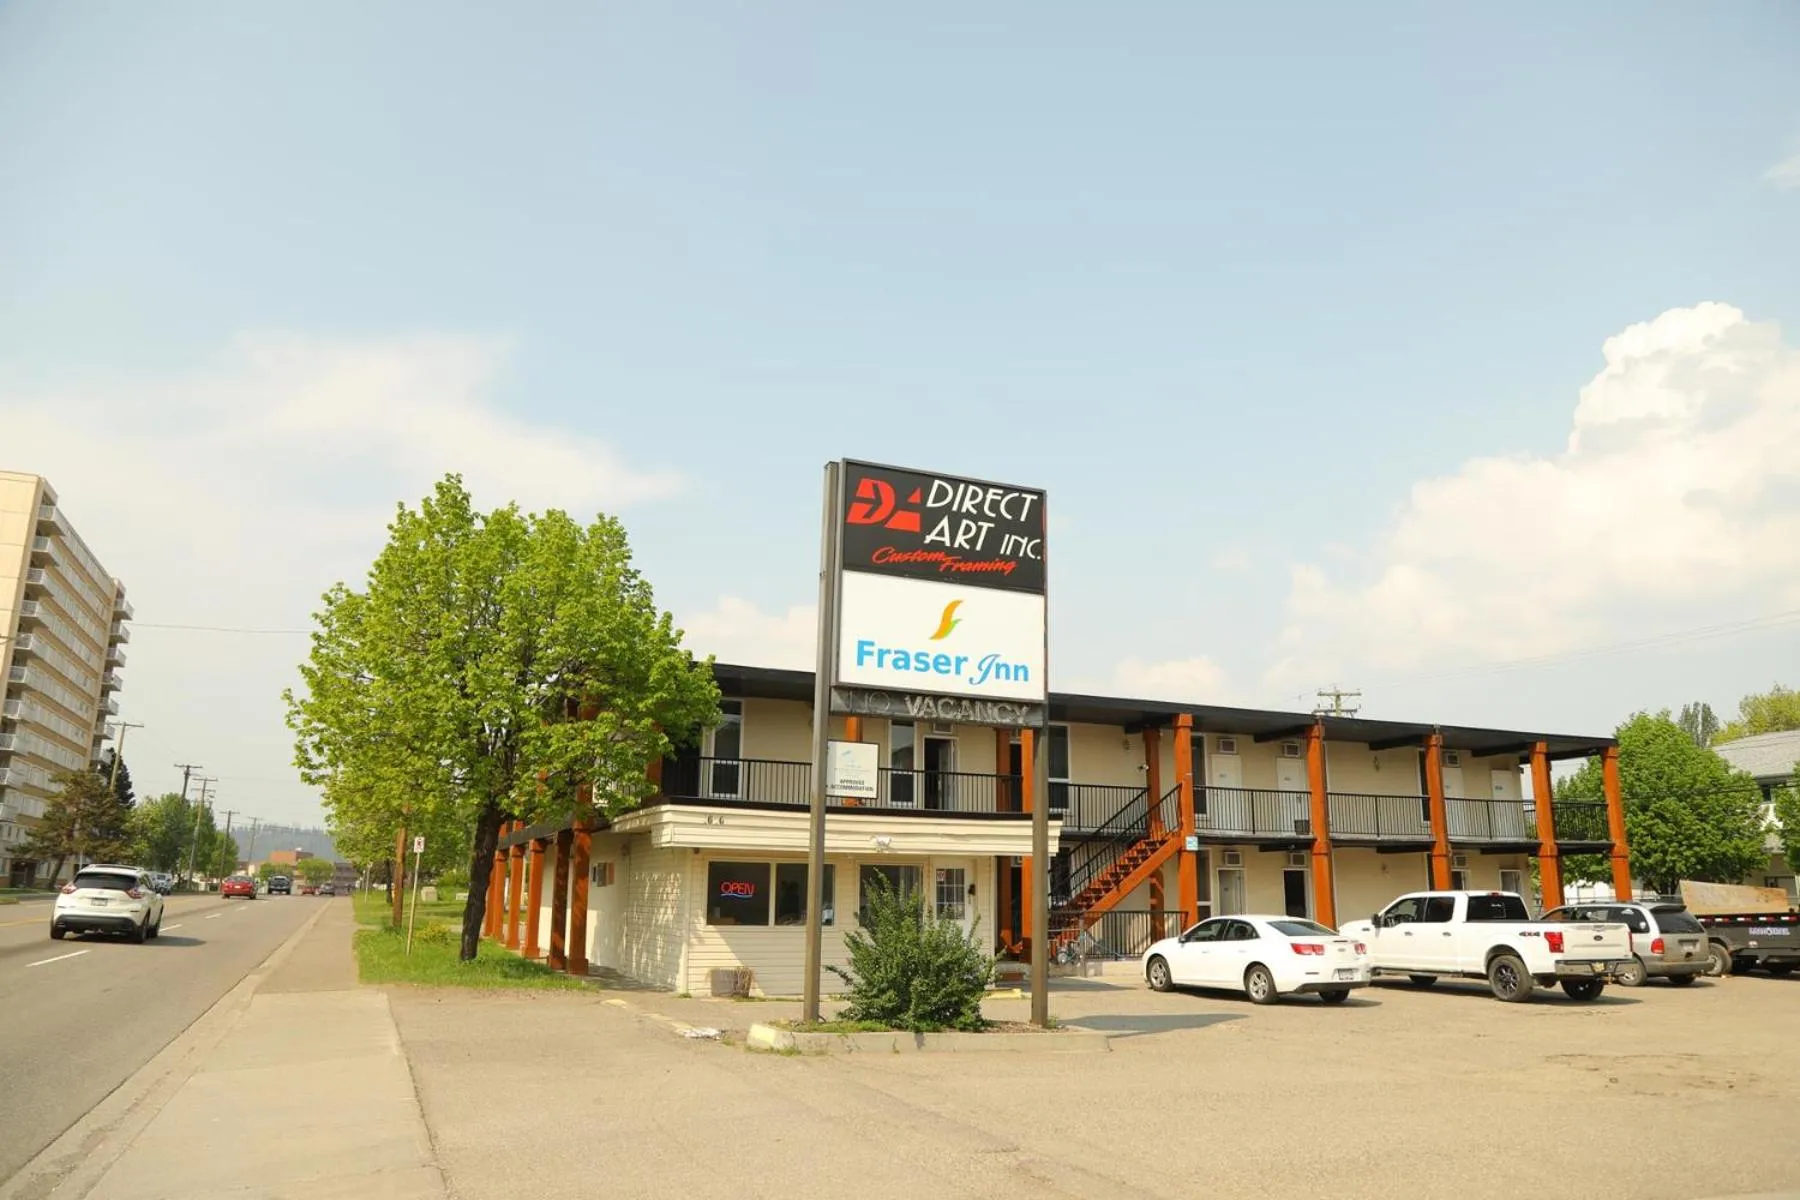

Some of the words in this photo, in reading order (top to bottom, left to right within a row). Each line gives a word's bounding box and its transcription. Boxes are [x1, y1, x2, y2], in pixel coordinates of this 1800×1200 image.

[926, 479, 1037, 522] DIRECT
[923, 515, 995, 551] ART
[871, 546, 945, 565] Custom
[939, 556, 1017, 576] Framing
[856, 639, 968, 676] Fraser
[968, 653, 1029, 685] Inn
[904, 694, 1031, 724] VACANCY
[720, 881, 755, 895] OPEN
